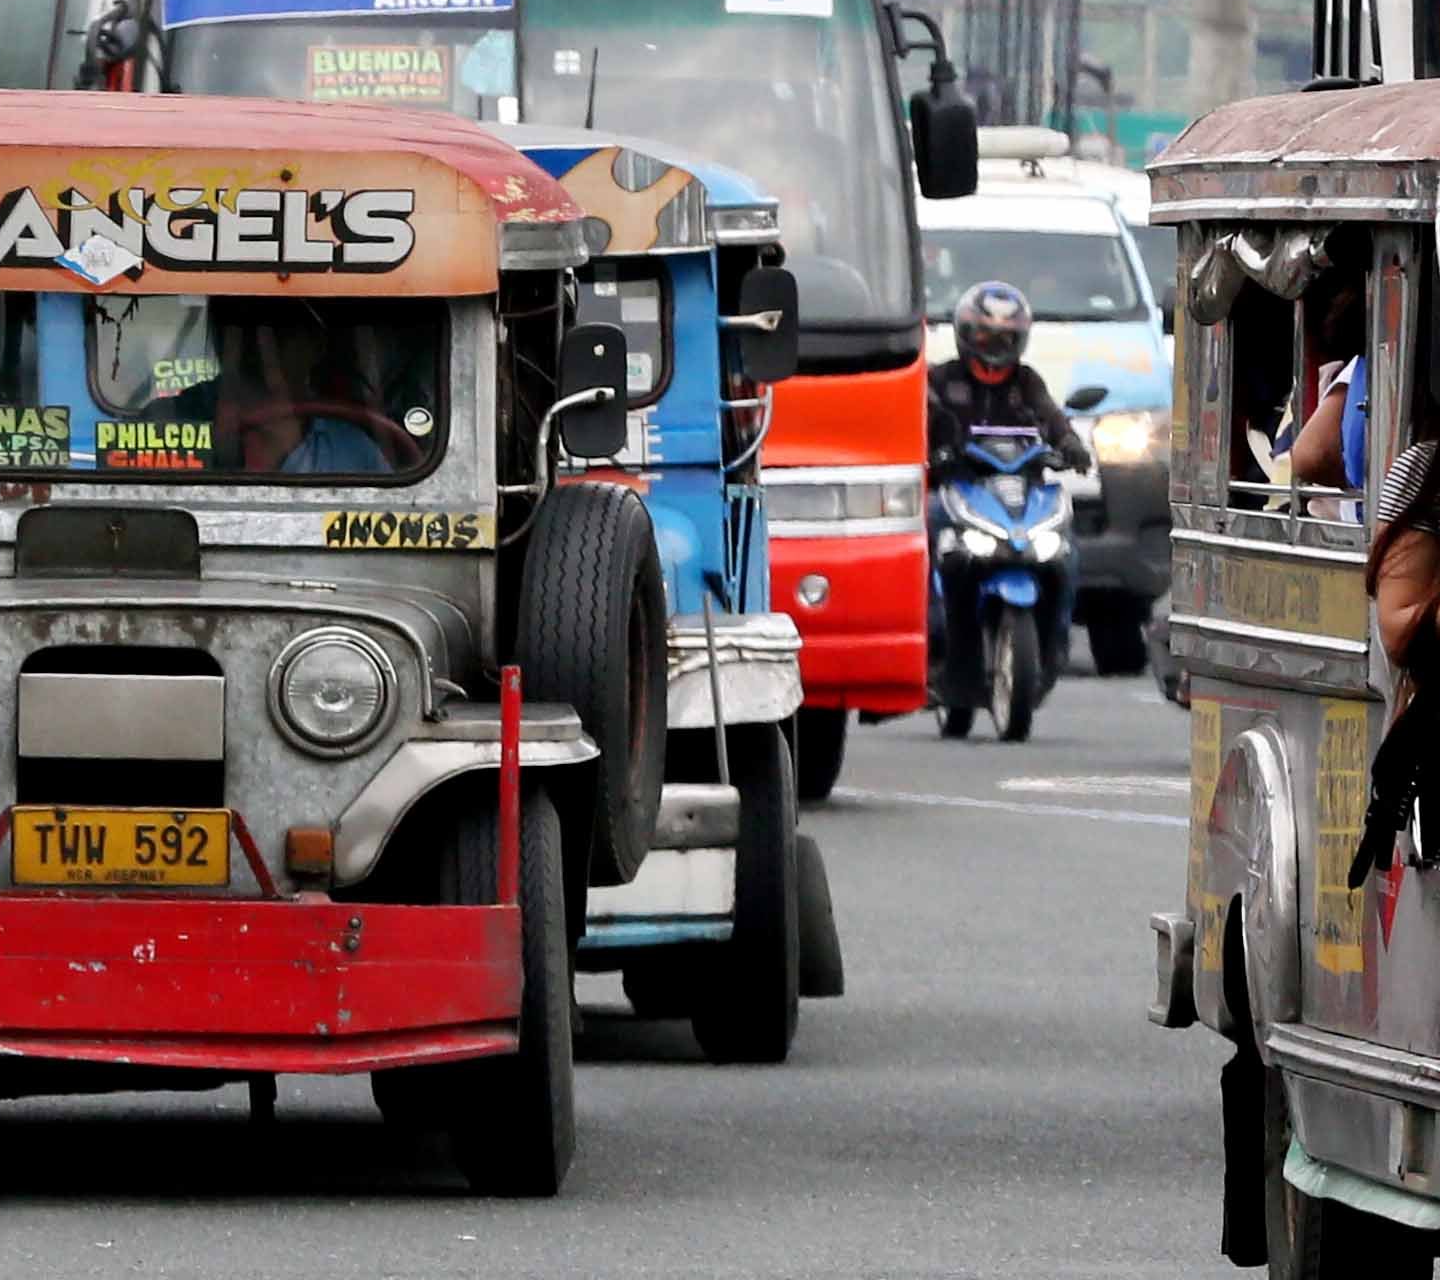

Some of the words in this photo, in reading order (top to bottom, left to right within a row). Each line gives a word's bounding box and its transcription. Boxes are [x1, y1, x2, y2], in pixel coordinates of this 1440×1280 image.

[315, 50, 442, 74] BUENDIA
[98, 422, 214, 450] PHILCOA
[326, 511, 479, 549] ANONAS
[134, 824, 209, 867] 592
